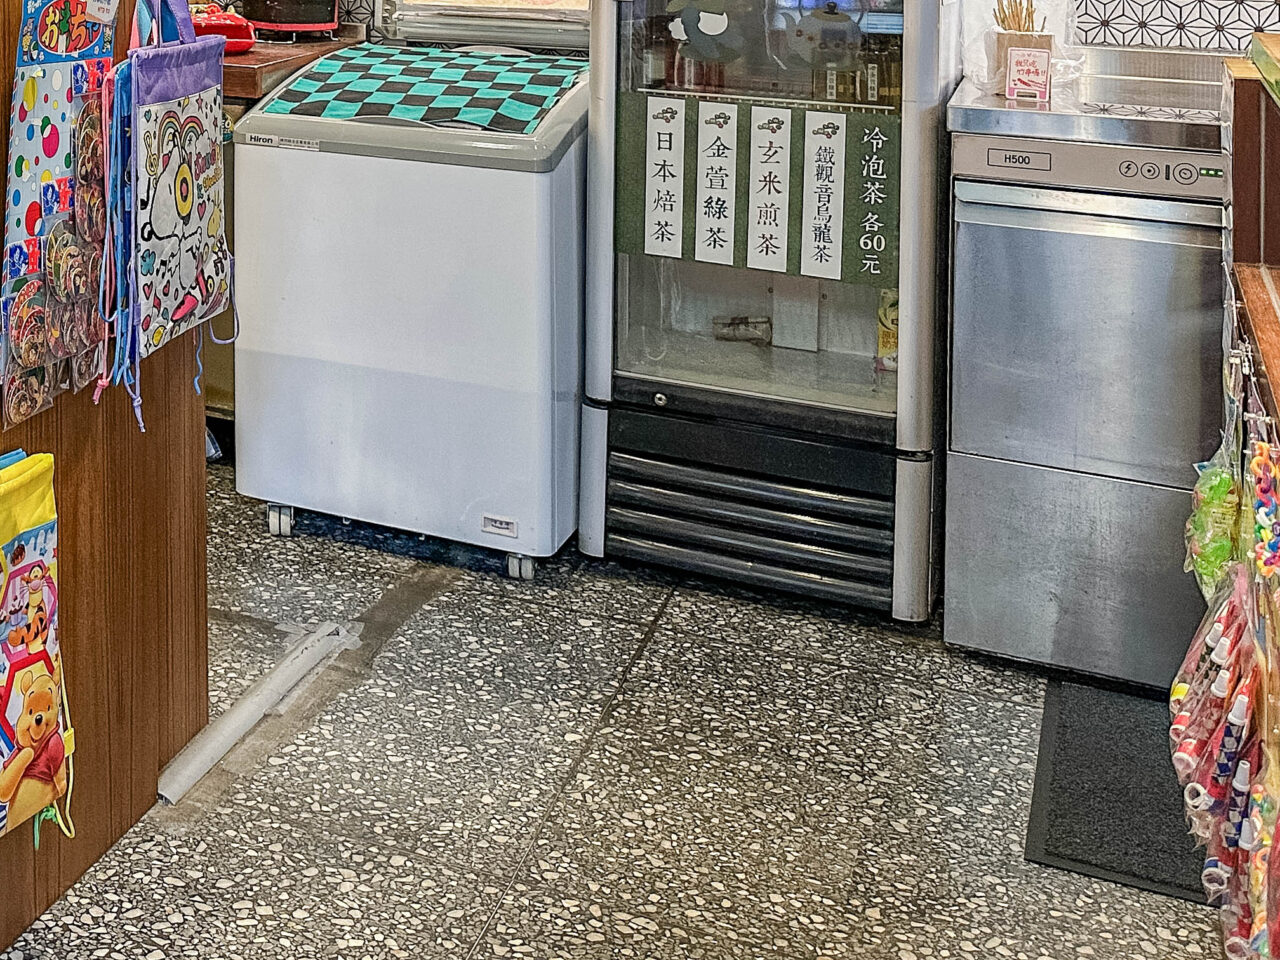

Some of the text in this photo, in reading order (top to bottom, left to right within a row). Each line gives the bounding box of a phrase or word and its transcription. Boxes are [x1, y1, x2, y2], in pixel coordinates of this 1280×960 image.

[650, 131, 677, 243] 日本焙茶
[702, 135, 734, 250] 金萱綠茶
[754, 140, 784, 256] 玄米煎茶
[811, 145, 836, 264] 鐵觀音烏龍茶
[1004, 153, 1031, 165] H500
